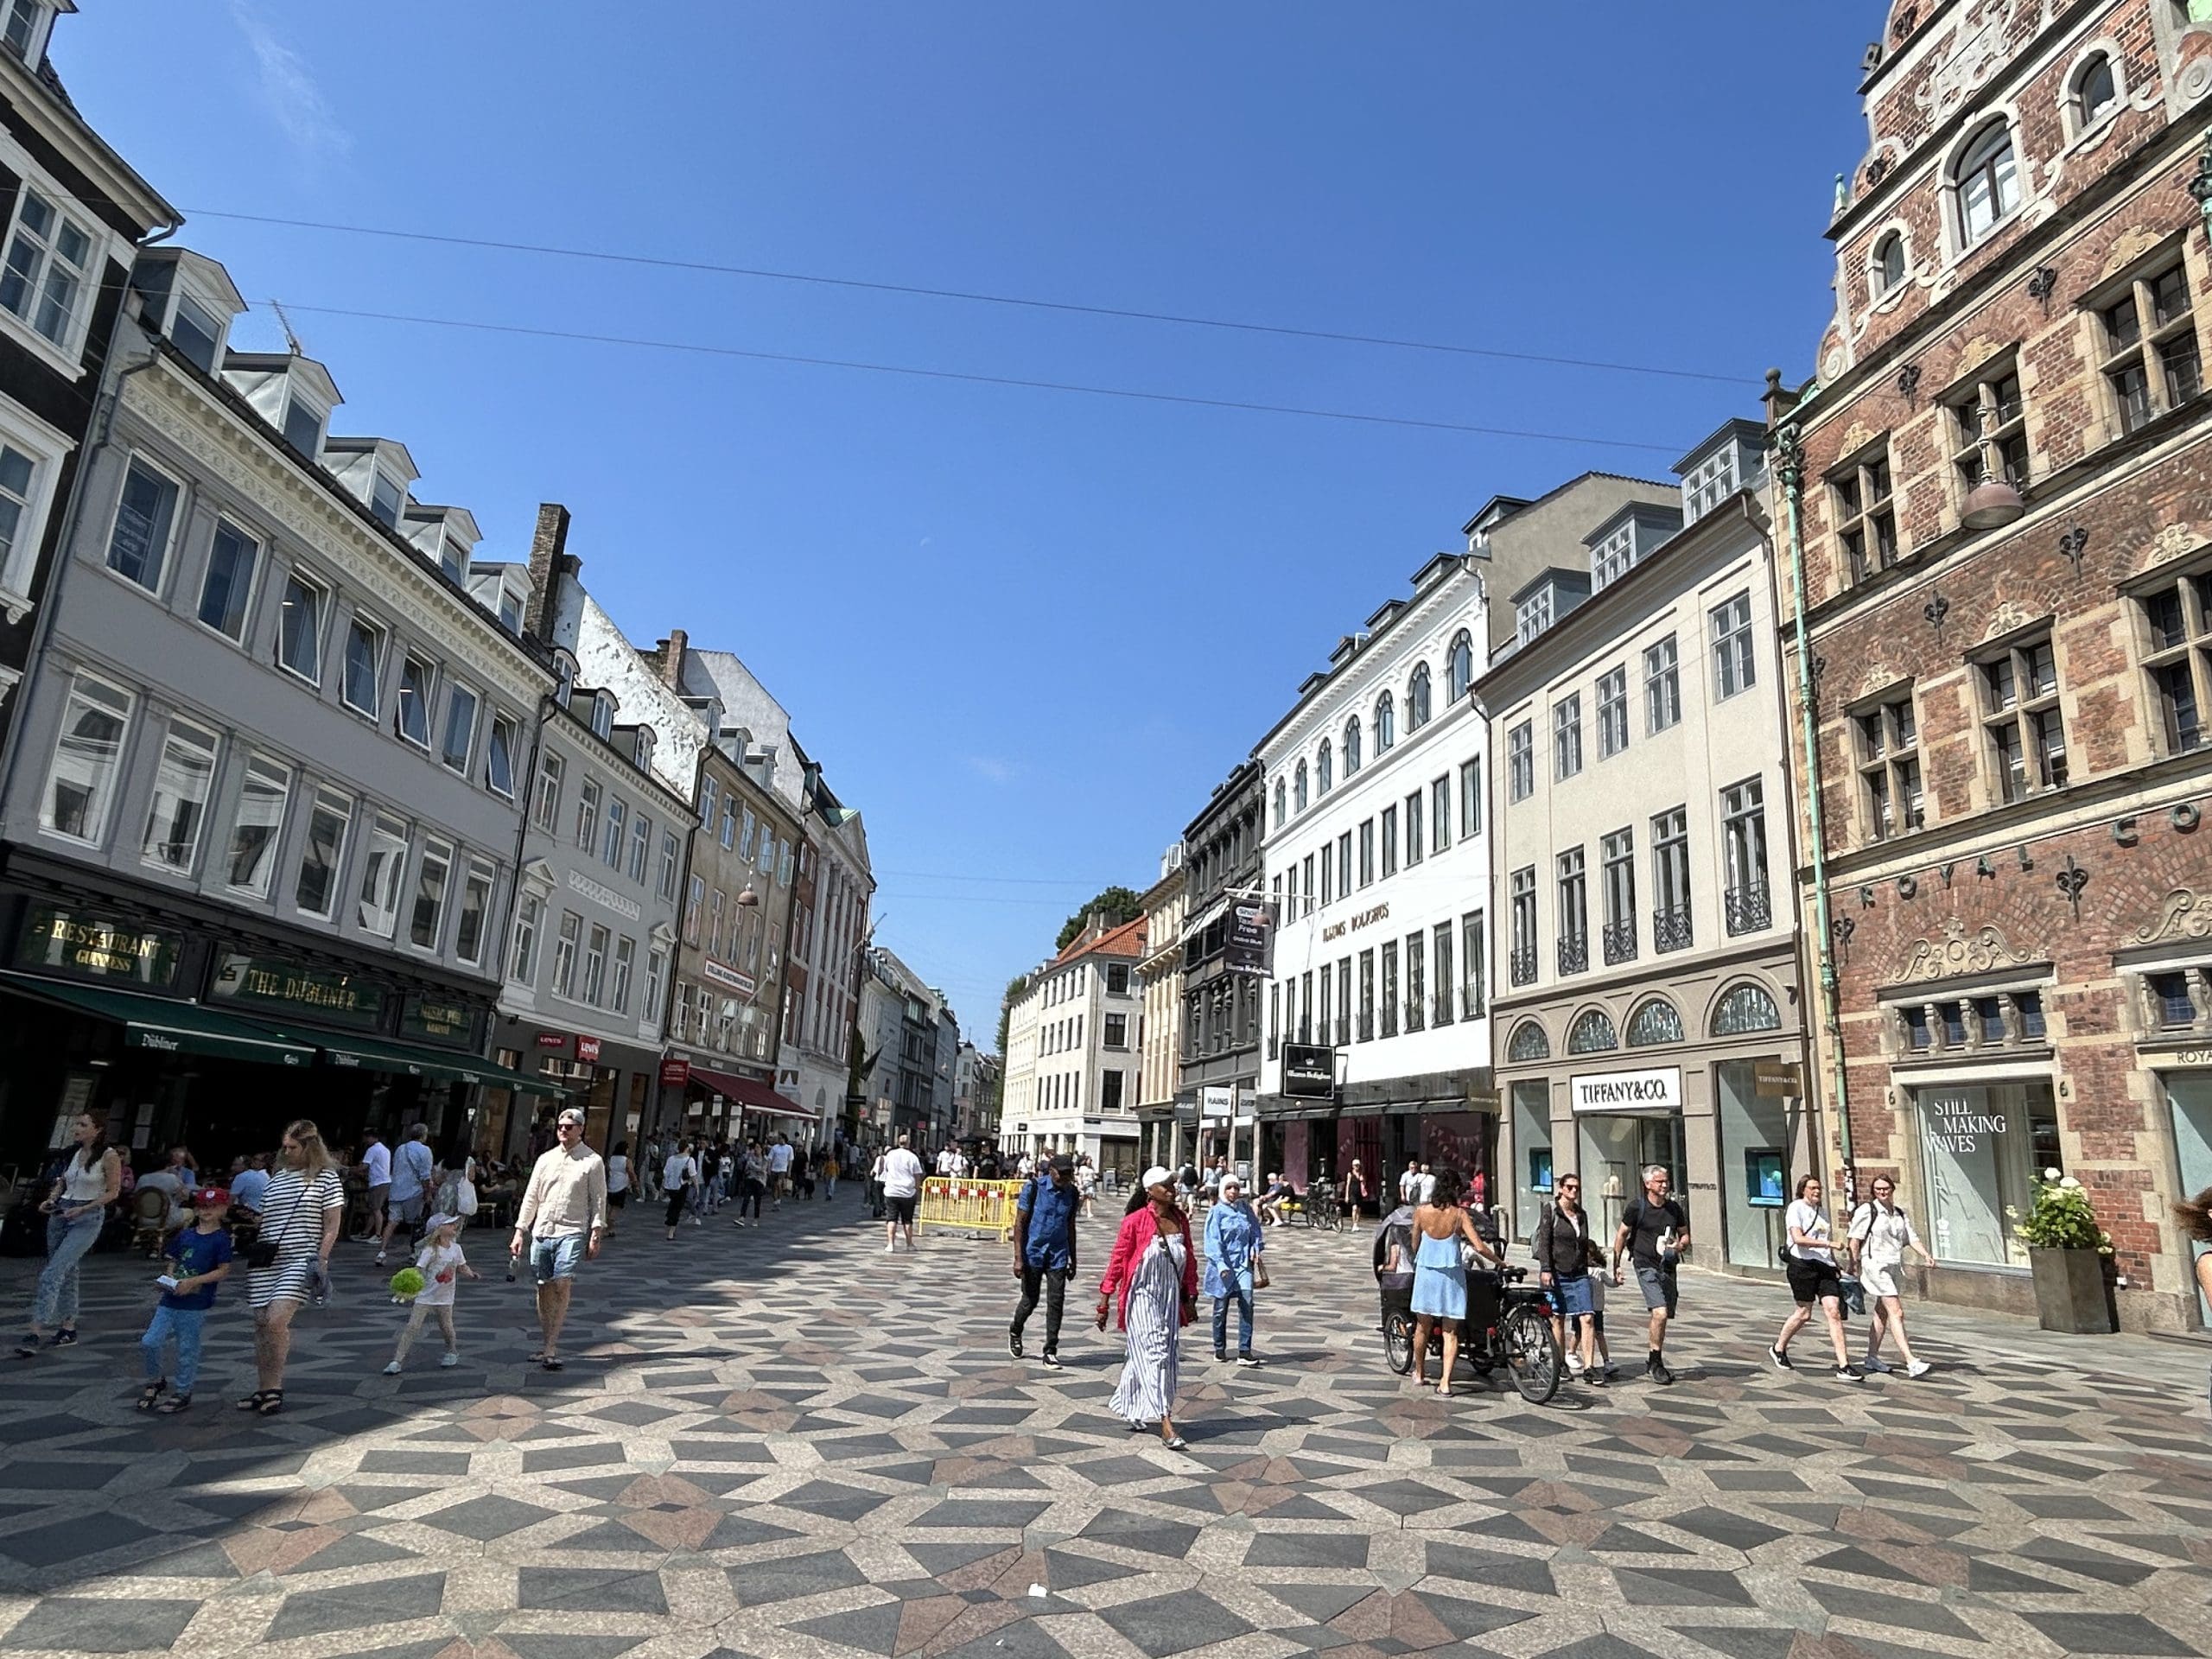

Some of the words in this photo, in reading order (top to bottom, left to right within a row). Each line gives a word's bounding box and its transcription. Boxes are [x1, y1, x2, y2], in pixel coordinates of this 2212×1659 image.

[1859, 844, 2034, 910] ROYAL
[51, 919, 162, 959] RESTAURANT
[248, 969, 280, 995] THE
[1887, 1090, 1897, 1106] 6
[2059, 1080, 2069, 1097] 6
[1207, 1096, 1230, 1106] RAINS
[1934, 1097, 1973, 1116] STILL
[1943, 1115, 2006, 1134] MAKING
[1925, 1134, 1976, 1153] WAVES
